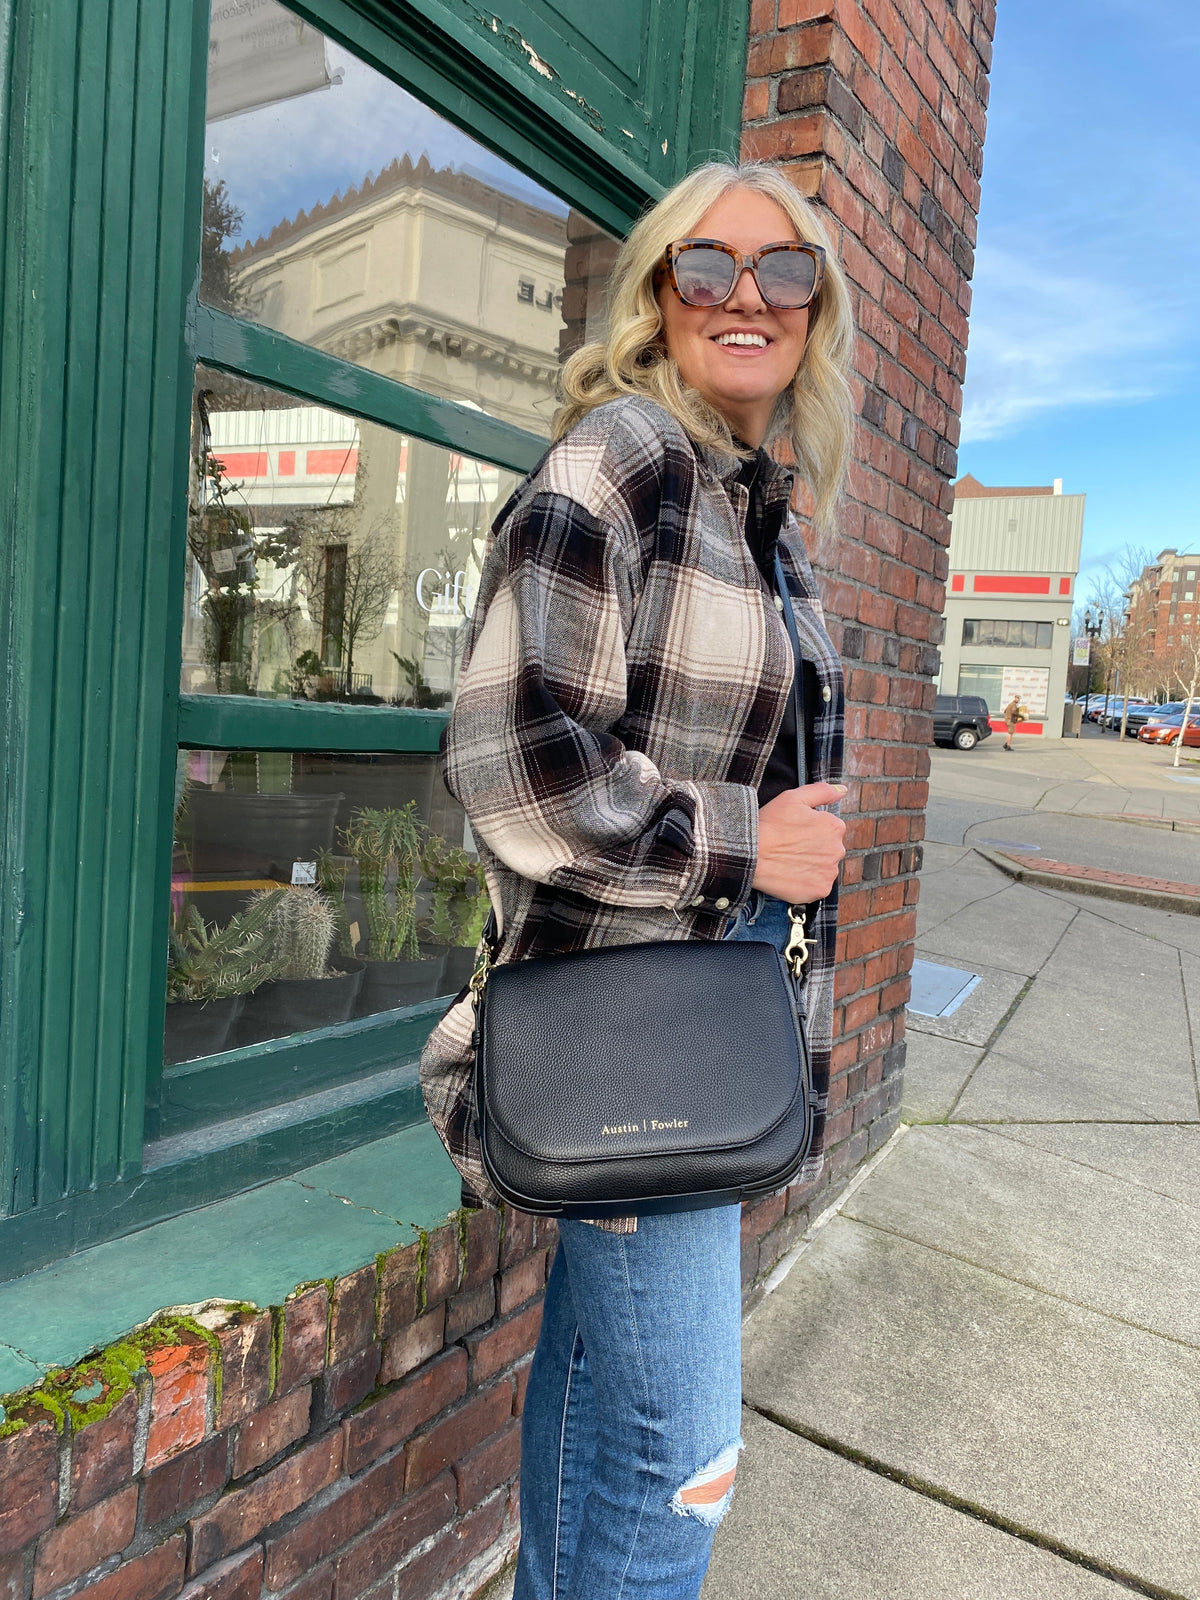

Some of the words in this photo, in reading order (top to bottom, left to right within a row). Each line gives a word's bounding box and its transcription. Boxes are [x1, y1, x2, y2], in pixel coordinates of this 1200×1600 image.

[416, 567, 473, 619] Gift
[601, 1122, 639, 1135] Austin
[651, 1118, 689, 1130] Fowler
